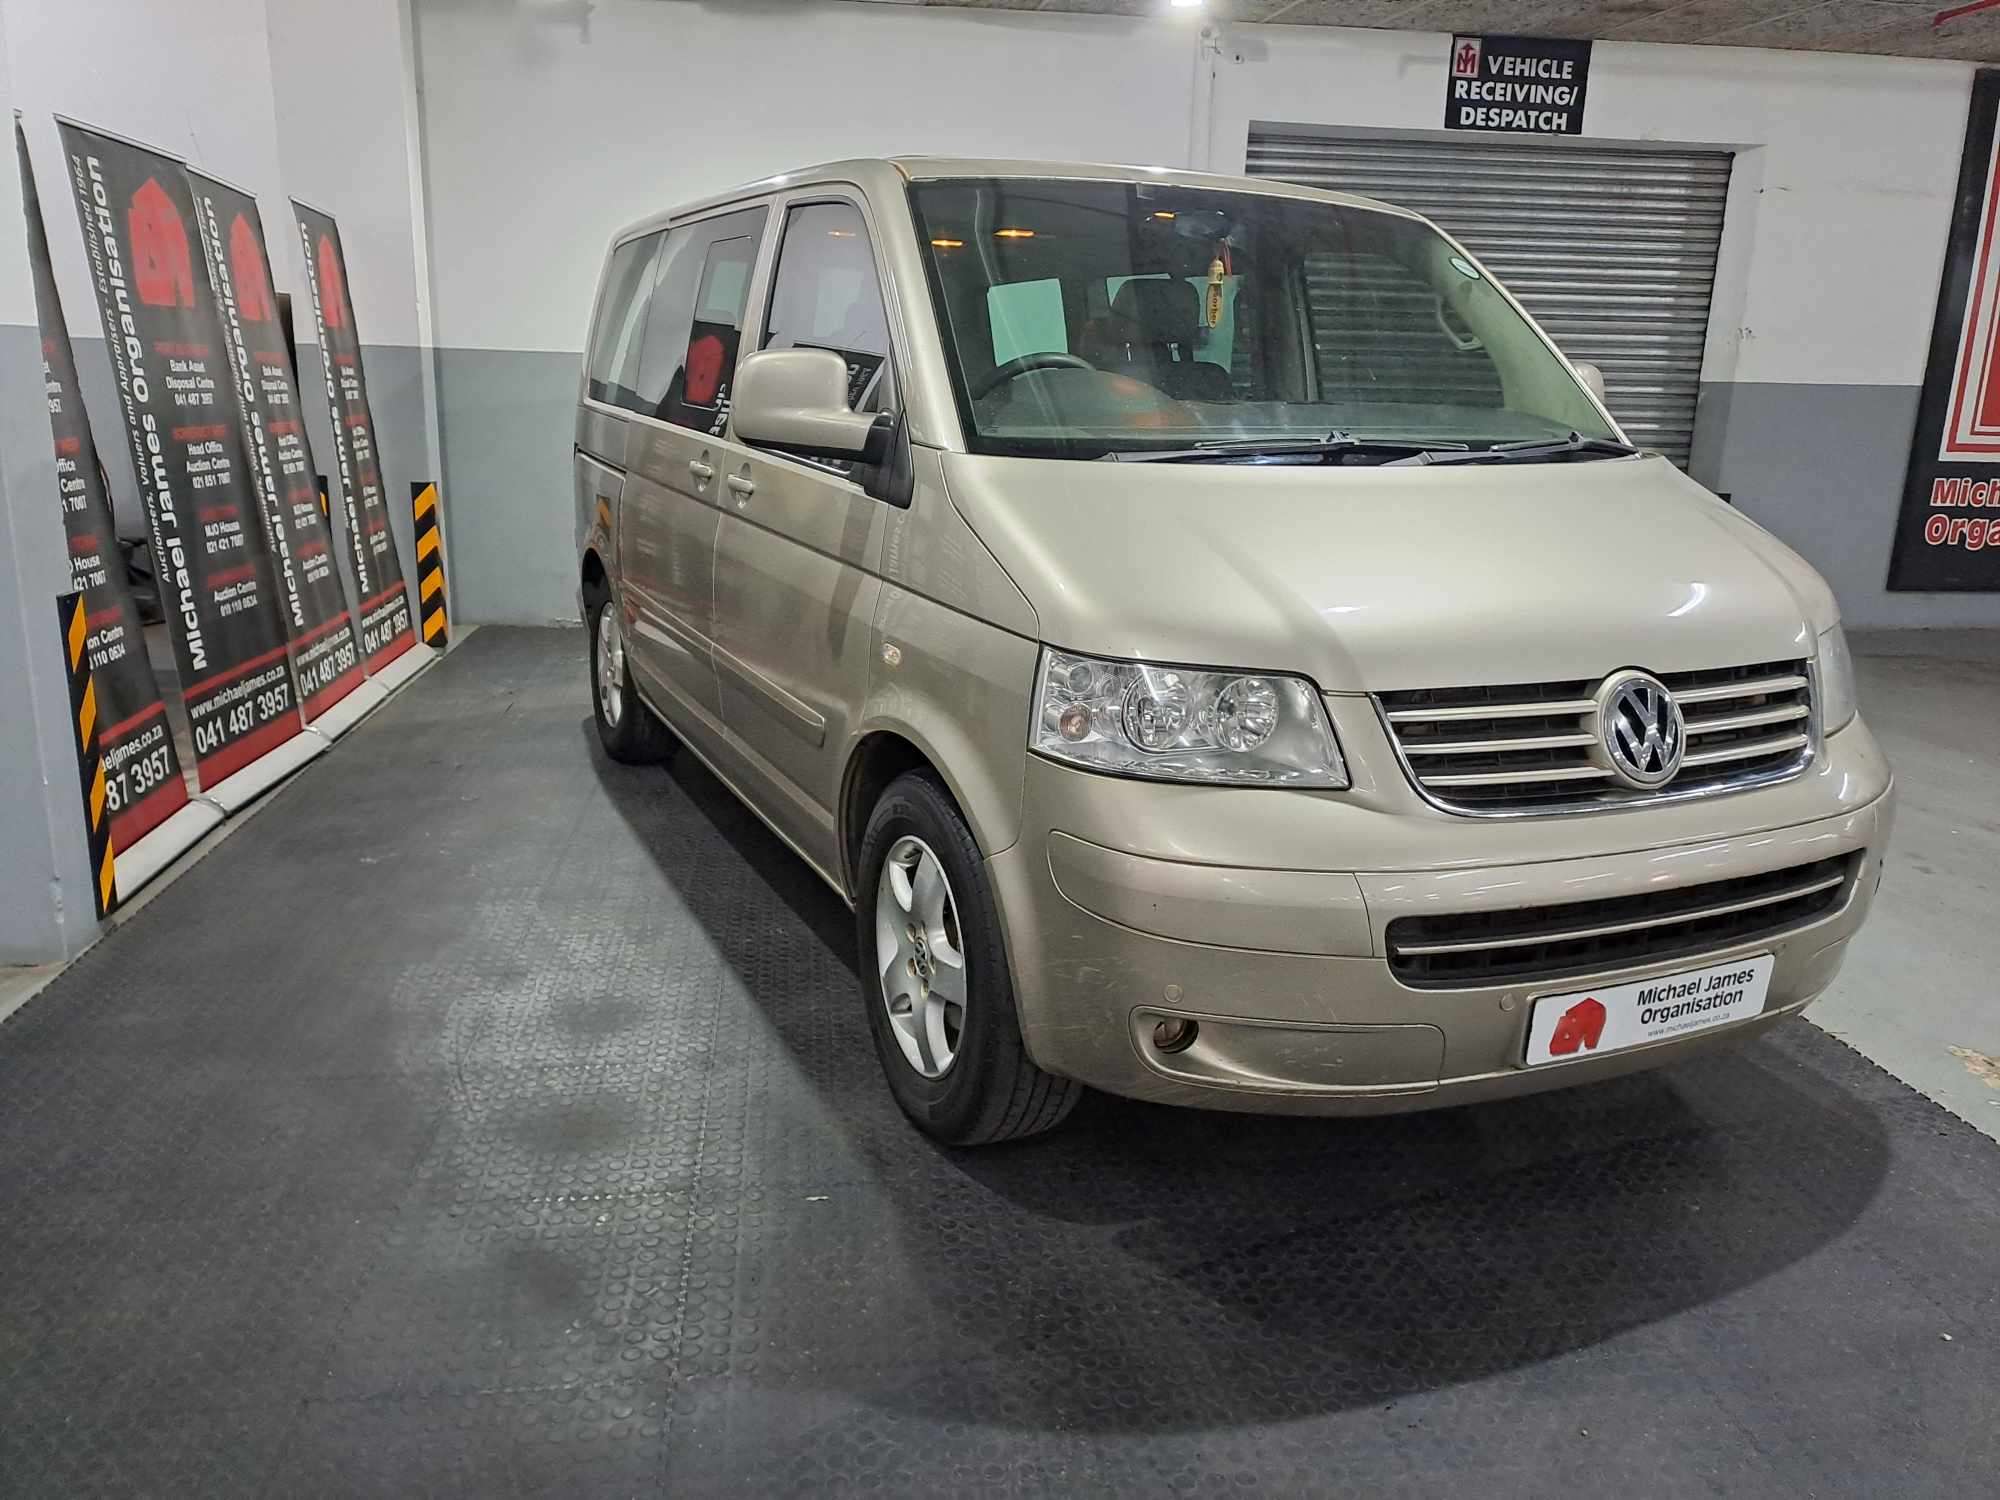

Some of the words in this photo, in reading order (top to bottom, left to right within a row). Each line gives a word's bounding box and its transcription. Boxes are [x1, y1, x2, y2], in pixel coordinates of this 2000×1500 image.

[1455, 80, 1579, 106] RECEIVING/
[1488, 55, 1574, 79] VEHICLE
[1460, 106, 1568, 131] DESPATCH
[72, 154, 88, 196] 1964
[81, 199, 109, 294] Established
[87, 155, 149, 403] Organisation
[204, 196, 255, 403] Organisation
[301, 221, 335, 399] Organisation
[105, 308, 130, 392] Appraisers
[123, 394, 137, 426] and
[132, 429, 150, 486] Valuers
[142, 413, 178, 529] James
[250, 411, 278, 507] James
[331, 406, 352, 489] James
[74, 554, 100, 571] House
[271, 514, 304, 627] Michael
[345, 495, 369, 593] Michael
[73, 576, 88, 591] 421
[166, 536, 208, 672] Michael
[100, 625, 124, 642] Centre
[364, 628, 381, 654] 041
[380, 619, 393, 643] 487
[190, 664, 285, 720] www.michaeljames.co.za
[300, 666, 319, 697] 041
[320, 655, 336, 683] 487
[334, 642, 356, 673] 3957
[195, 717, 226, 754] 041
[228, 700, 254, 735] 487
[256, 682, 289, 721] 3957
[131, 745, 170, 793] 3957
[1637, 977, 1702, 1006] Michael
[1703, 968, 1755, 992] James
[1640, 989, 1743, 1024] Organisation
